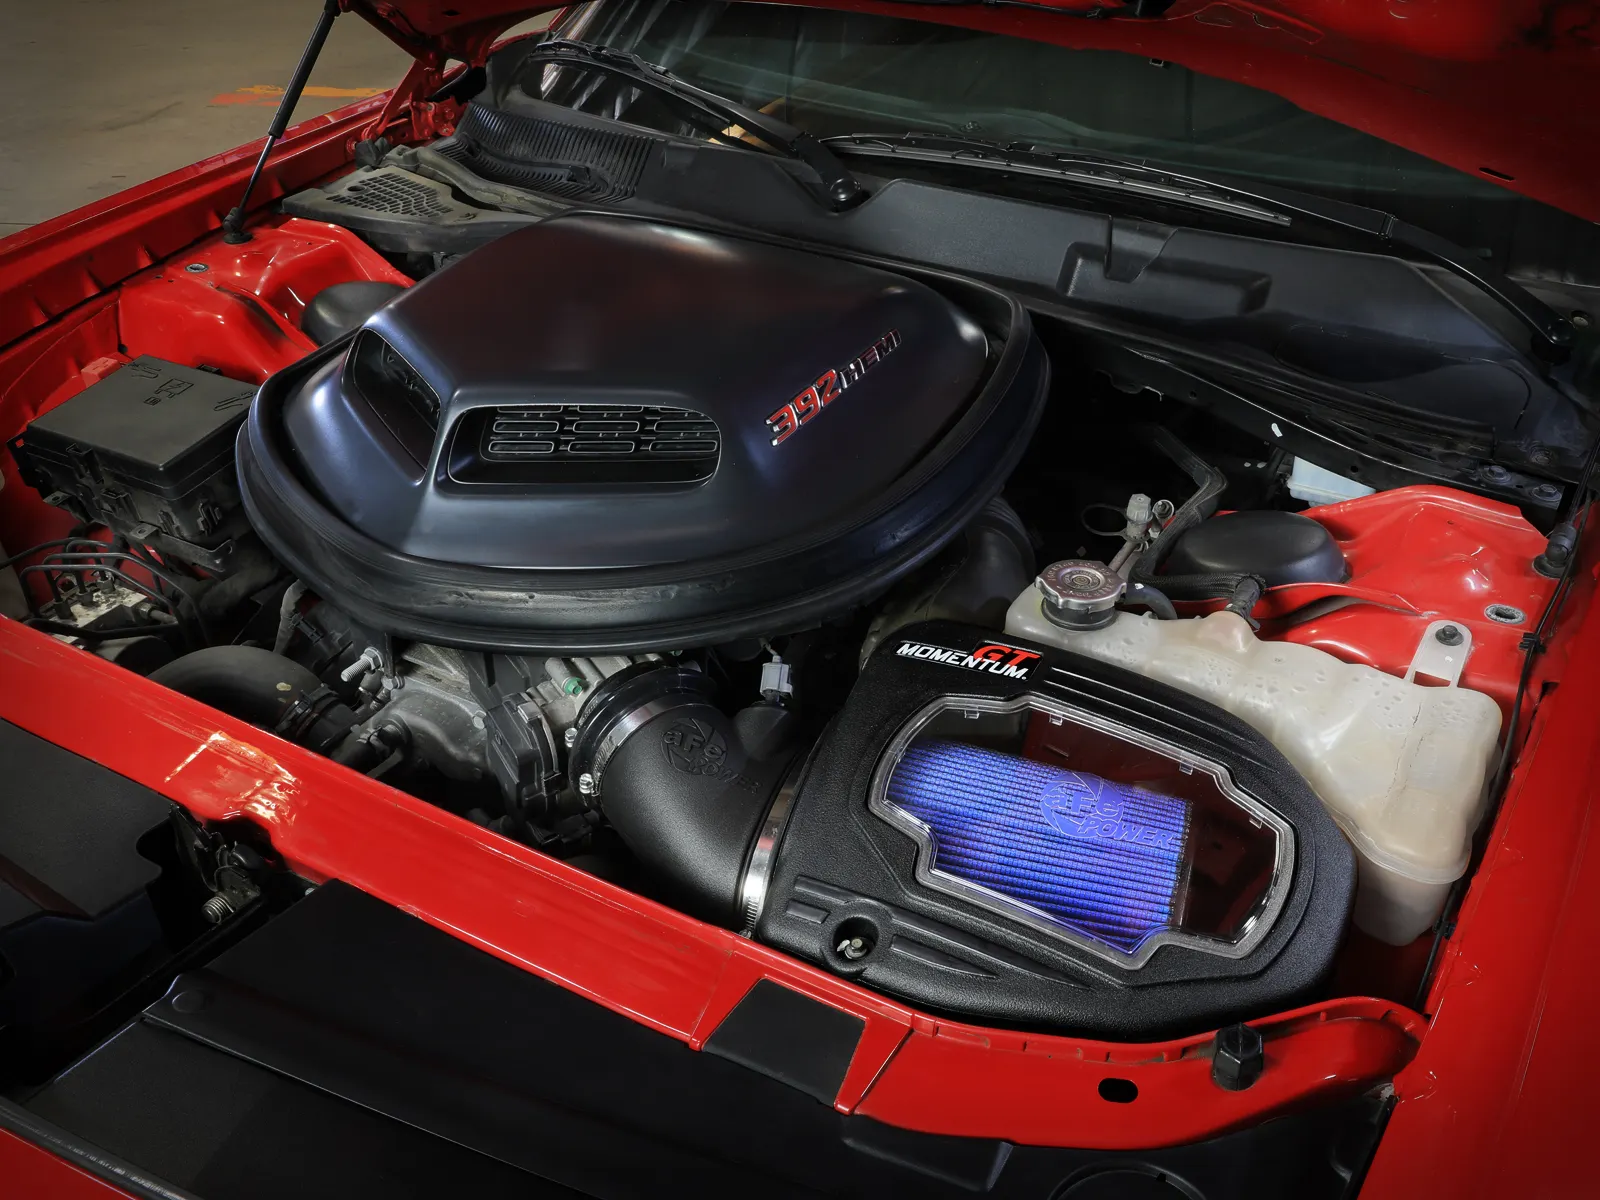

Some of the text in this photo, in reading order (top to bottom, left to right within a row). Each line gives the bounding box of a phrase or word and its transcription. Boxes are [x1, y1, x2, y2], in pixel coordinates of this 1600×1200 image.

[765, 328, 902, 447] 392 HEMI
[973, 645, 1041, 667] GT
[1043, 792, 1124, 817] aFe
[1077, 814, 1174, 849] POWER
